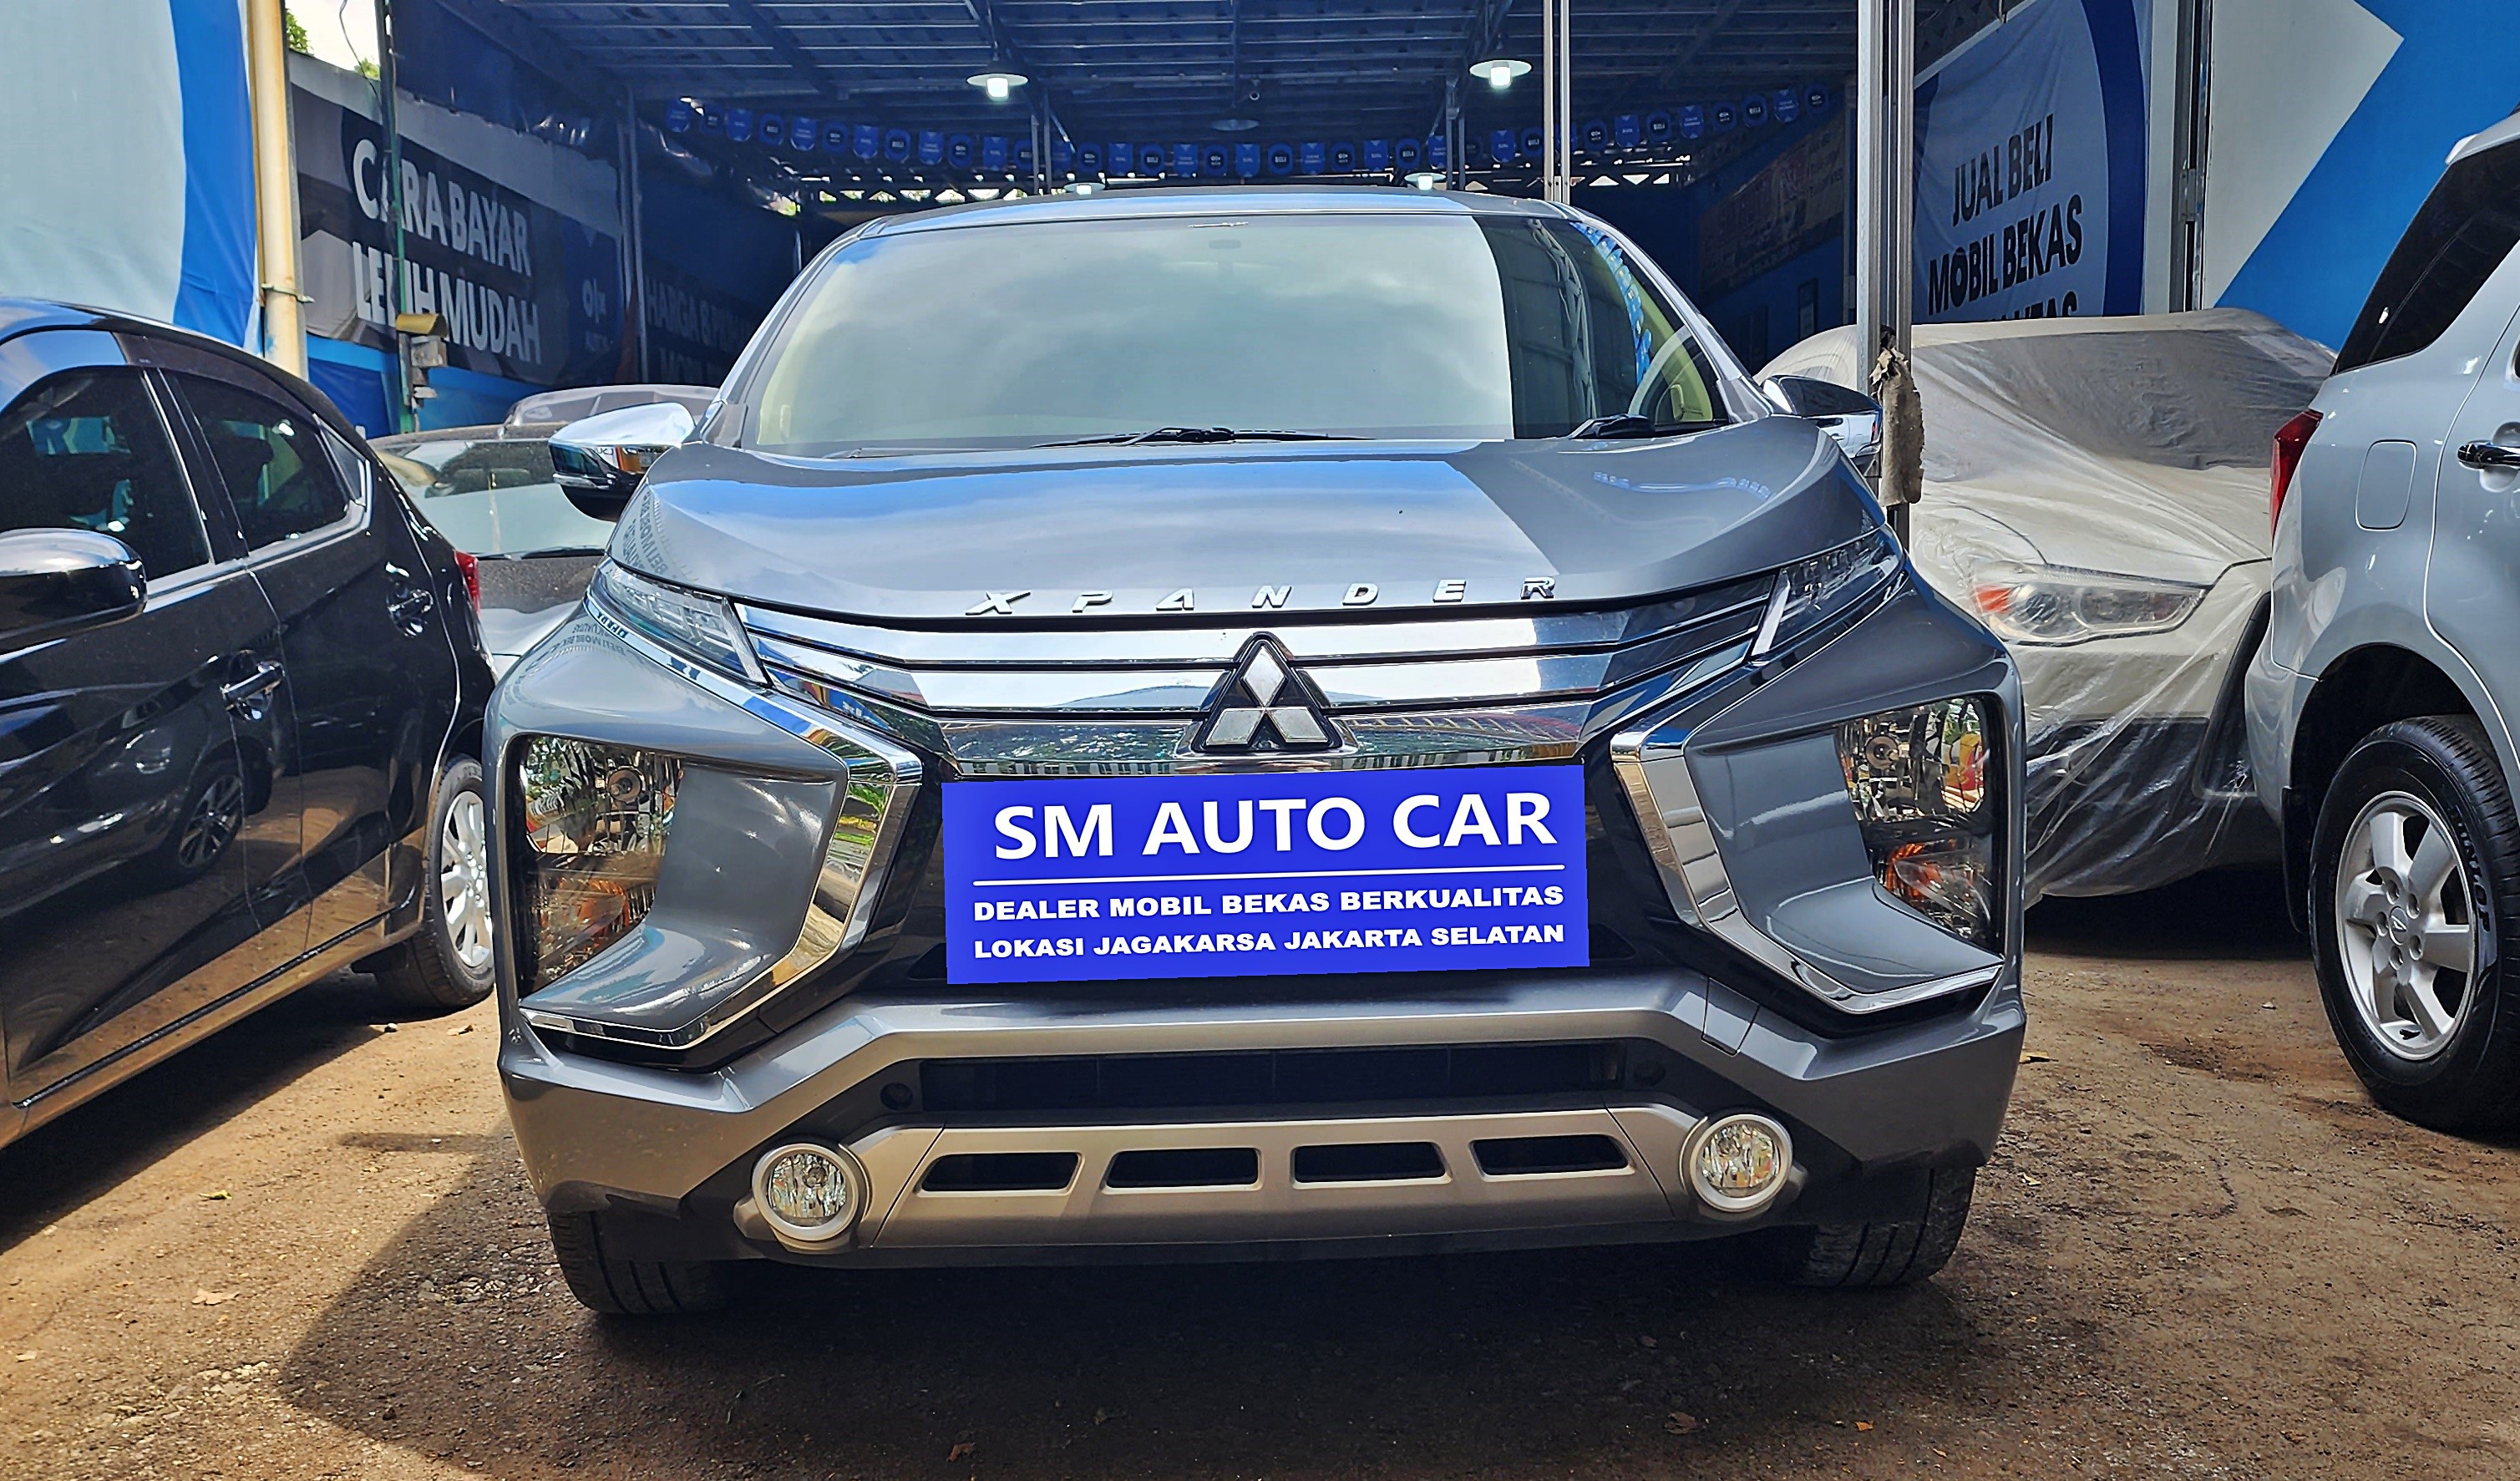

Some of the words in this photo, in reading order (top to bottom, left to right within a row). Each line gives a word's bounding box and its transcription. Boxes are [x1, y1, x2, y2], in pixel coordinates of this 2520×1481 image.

[1952, 145, 2003, 226] JUAL
[2008, 114, 2054, 200] BELI
[449, 180, 533, 277] BAYAR
[1928, 234, 1999, 316] MOBIL
[2003, 194, 2083, 289] BEKAS
[439, 271, 543, 365] MUDAH
[965, 576, 1556, 616] XPANDER
